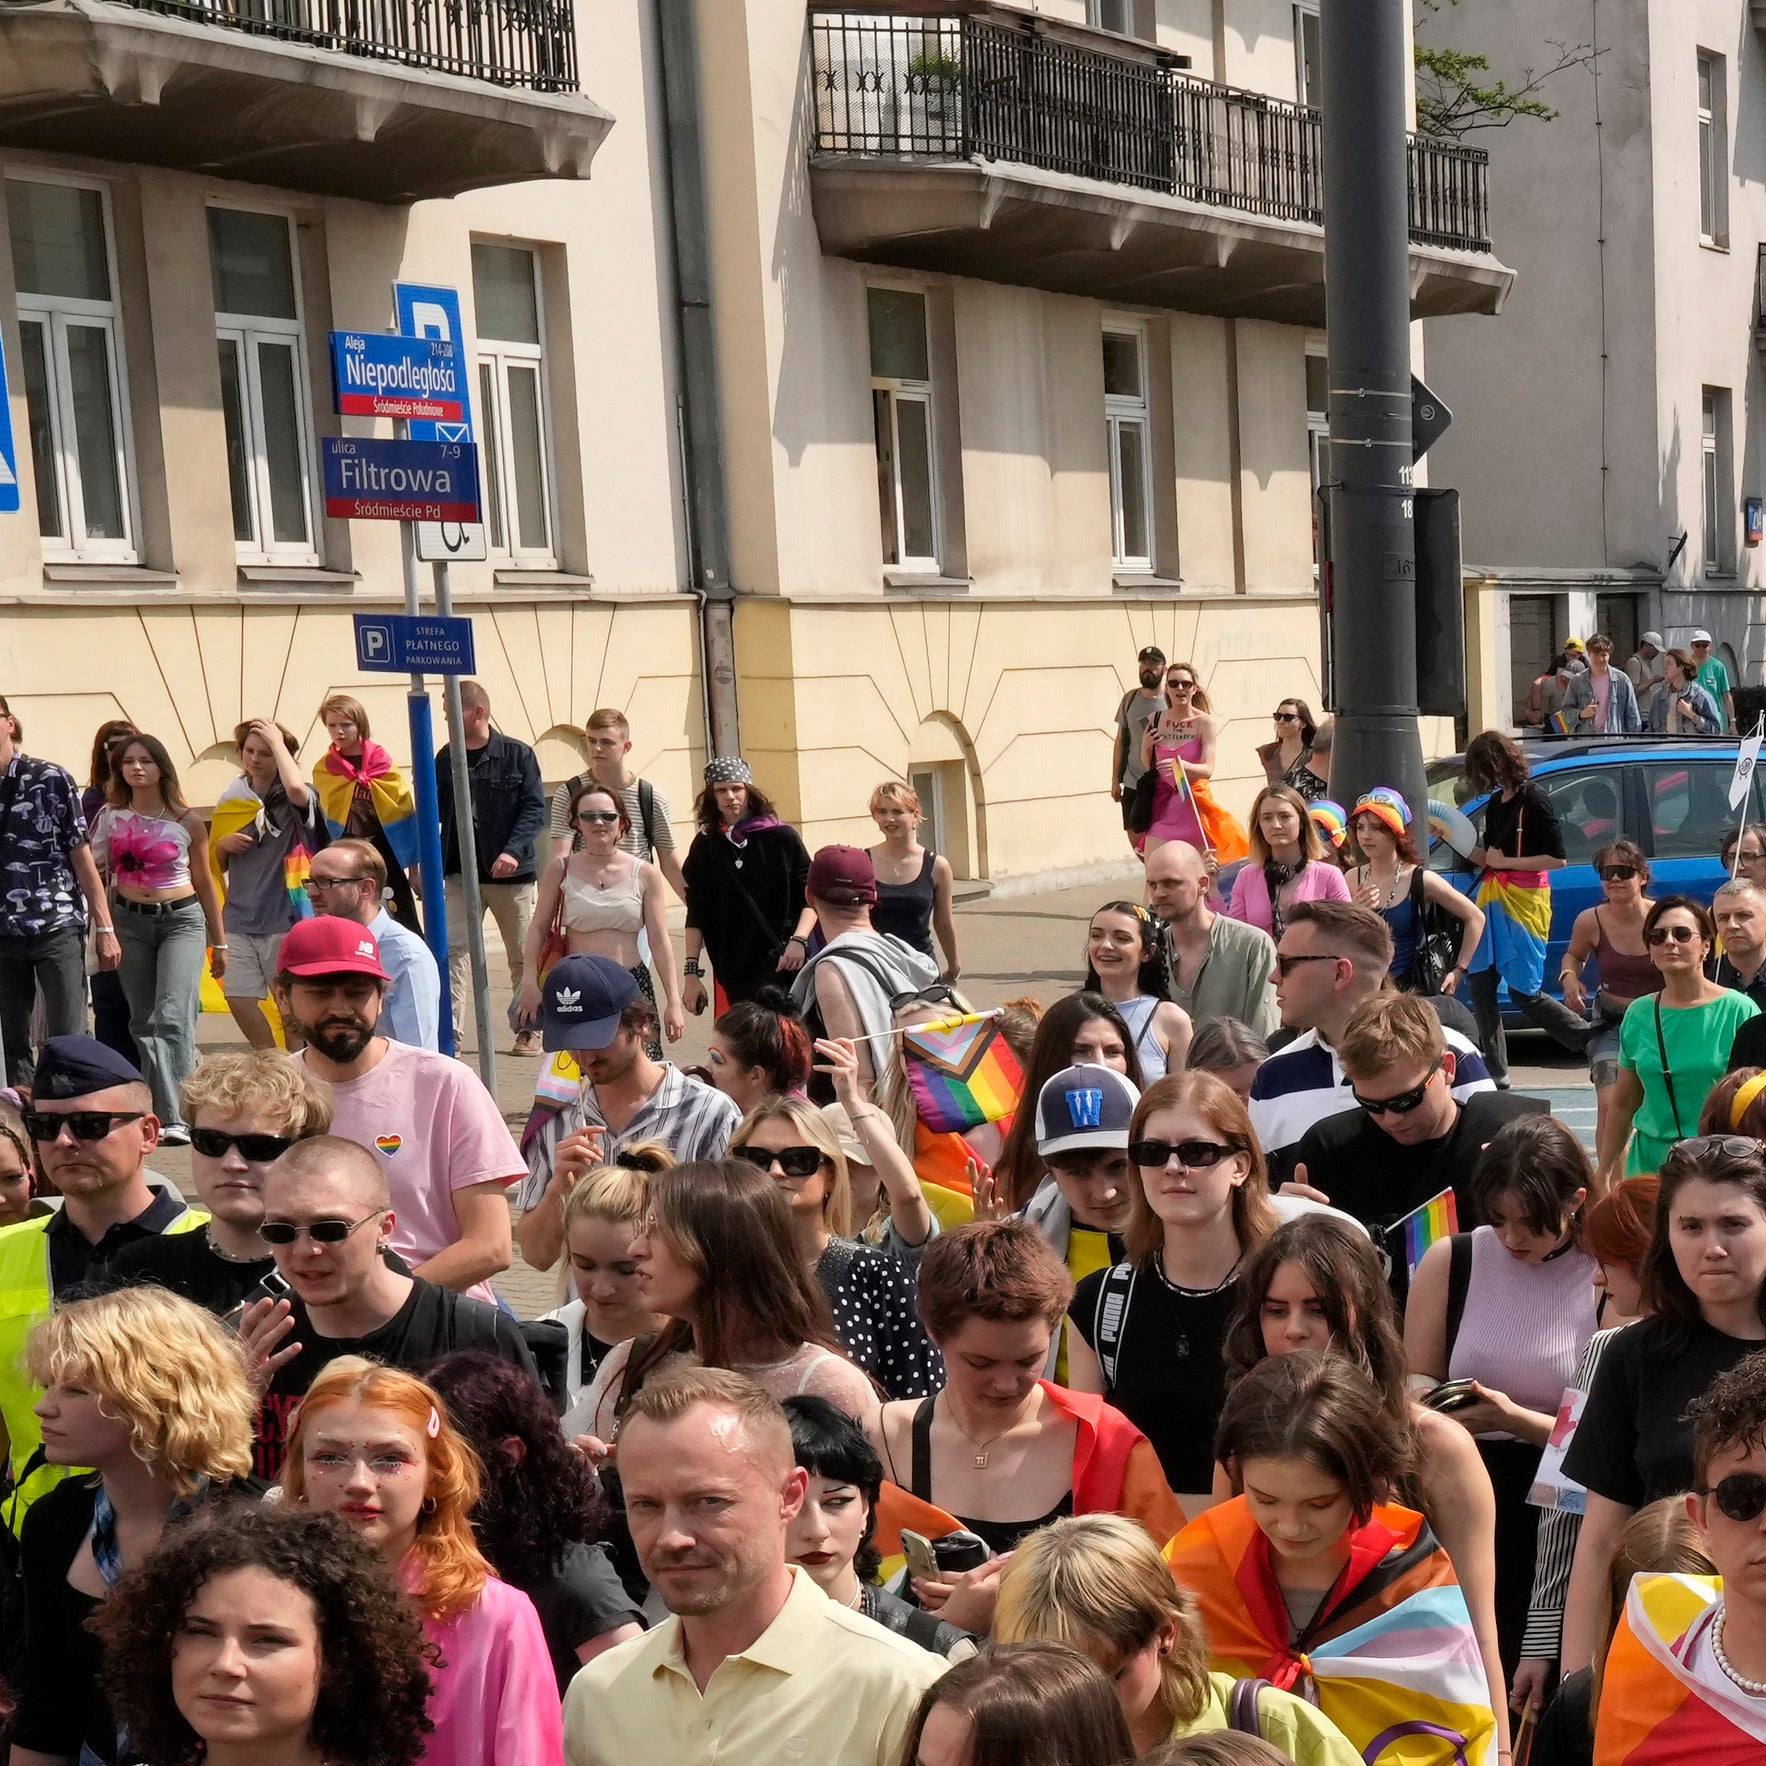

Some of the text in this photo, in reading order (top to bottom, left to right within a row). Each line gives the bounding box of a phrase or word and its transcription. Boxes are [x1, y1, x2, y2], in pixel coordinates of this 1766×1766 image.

[345, 336, 453, 358] Aleja 214-208
[346, 354, 456, 399] Niepodległości
[373, 397, 444, 417] Śródmieście Południowe
[331, 440, 461, 459] ulica 7-9
[340, 457, 451, 493] Filtrowa
[354, 499, 441, 519] Śródmieście Pd
[416, 627, 445, 636] STREFA
[406, 640, 460, 652] PŁATNEGO
[405, 655, 463, 666] PARKOWANIA
[1165, 720, 1194, 729] FUCK
[556, 1004, 583, 1013] adidas
[1064, 1087, 1104, 1129] W
[1100, 1292, 1125, 1343] PUMA
